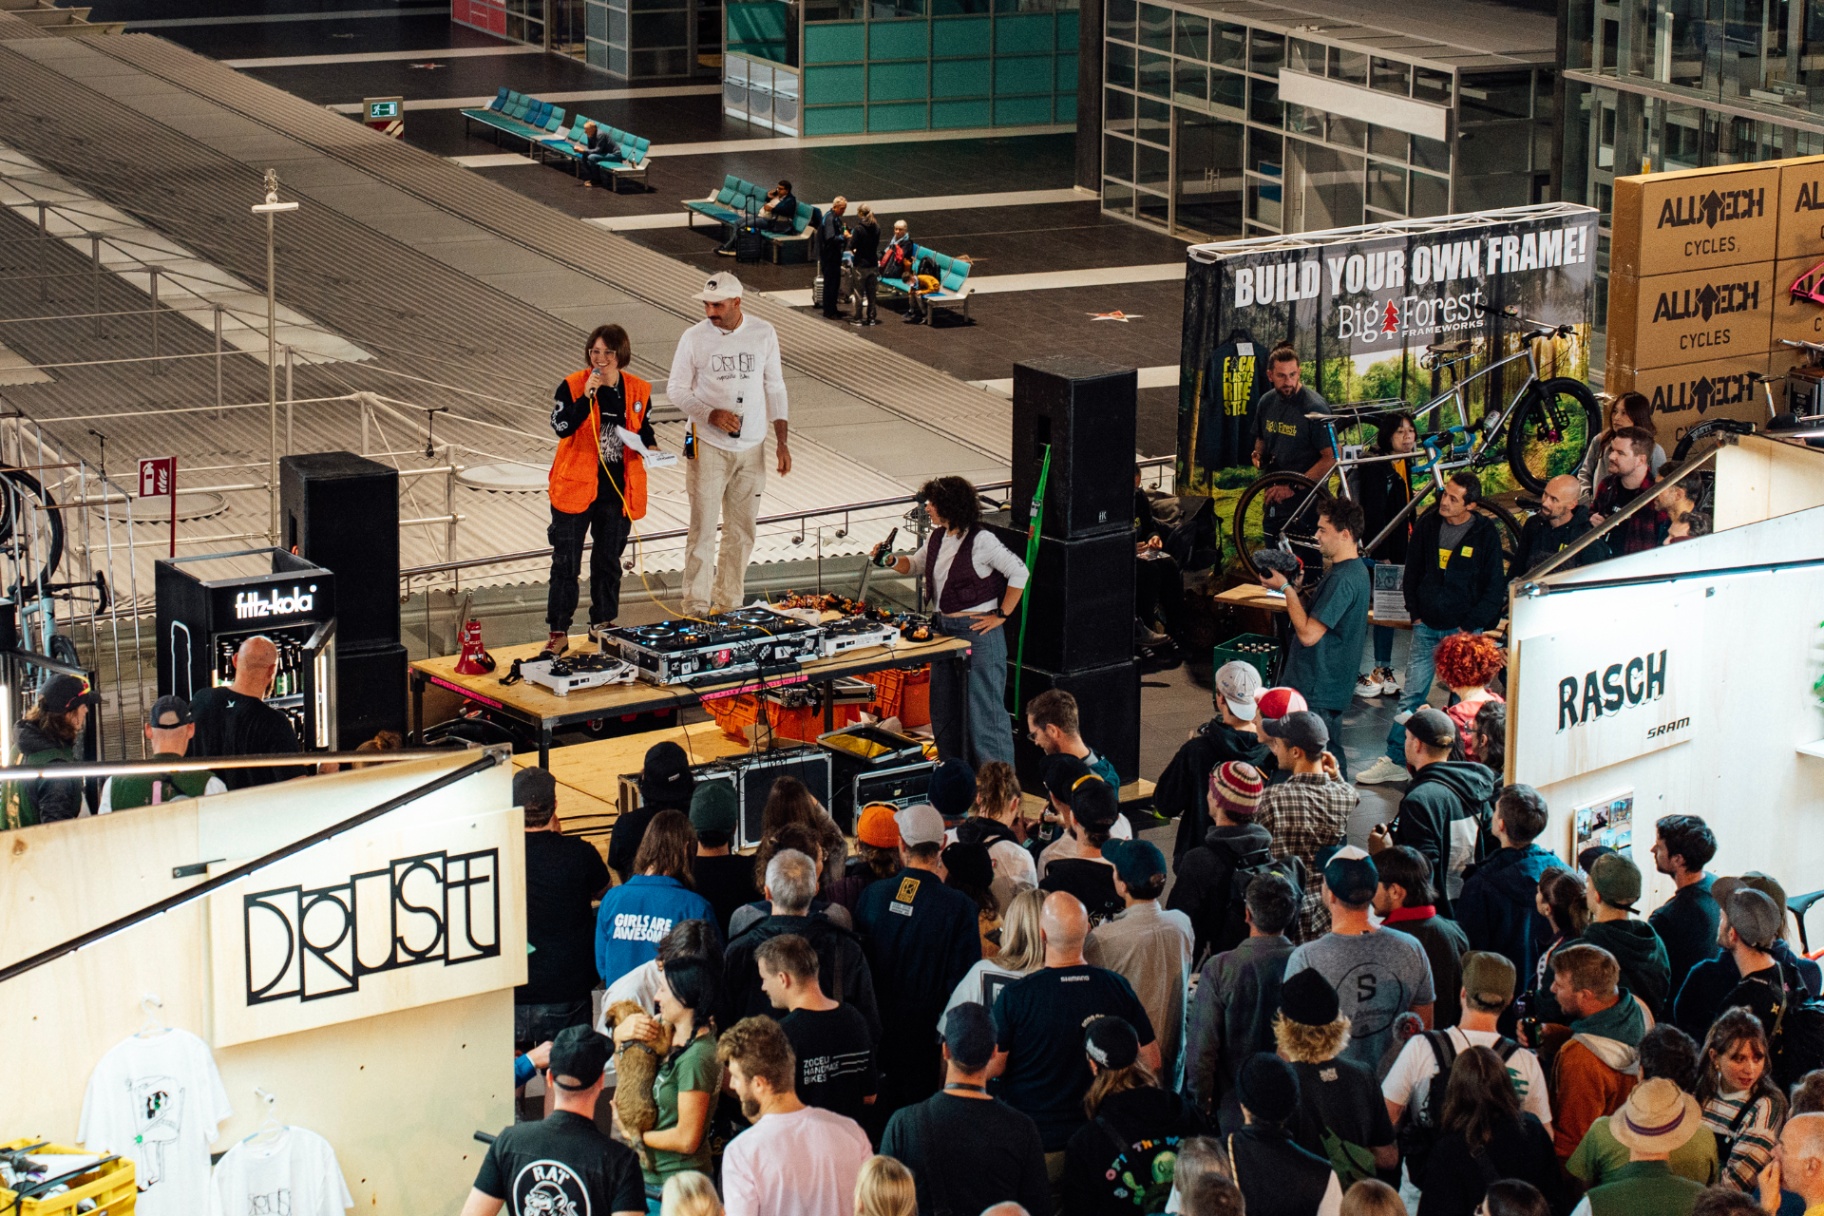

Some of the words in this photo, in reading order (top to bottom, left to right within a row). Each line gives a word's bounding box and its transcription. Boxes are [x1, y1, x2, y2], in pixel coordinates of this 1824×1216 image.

[1684, 236, 1736, 257] CYCLES
[1235, 260, 1321, 308] BUILD
[1327, 250, 1405, 296] YOUR
[1412, 239, 1480, 285] OWN
[1486, 226, 1587, 275] FRAME!
[1338, 301, 1379, 343] Big
[1402, 287, 1486, 330] Forest
[1402, 319, 1484, 338] FRAMEWORKS
[1680, 328, 1731, 350] CYCLES
[235, 586, 313, 619] fritz-kola
[1557, 650, 1667, 732] RASCH
[1647, 716, 1690, 739] SRAM
[614, 913, 650, 928] GIRLS
[650, 916, 672, 932] ARE
[1357, 973, 1376, 1003] S
[803, 1073, 827, 1085] BIKES
[532, 1166, 570, 1185] RAT
